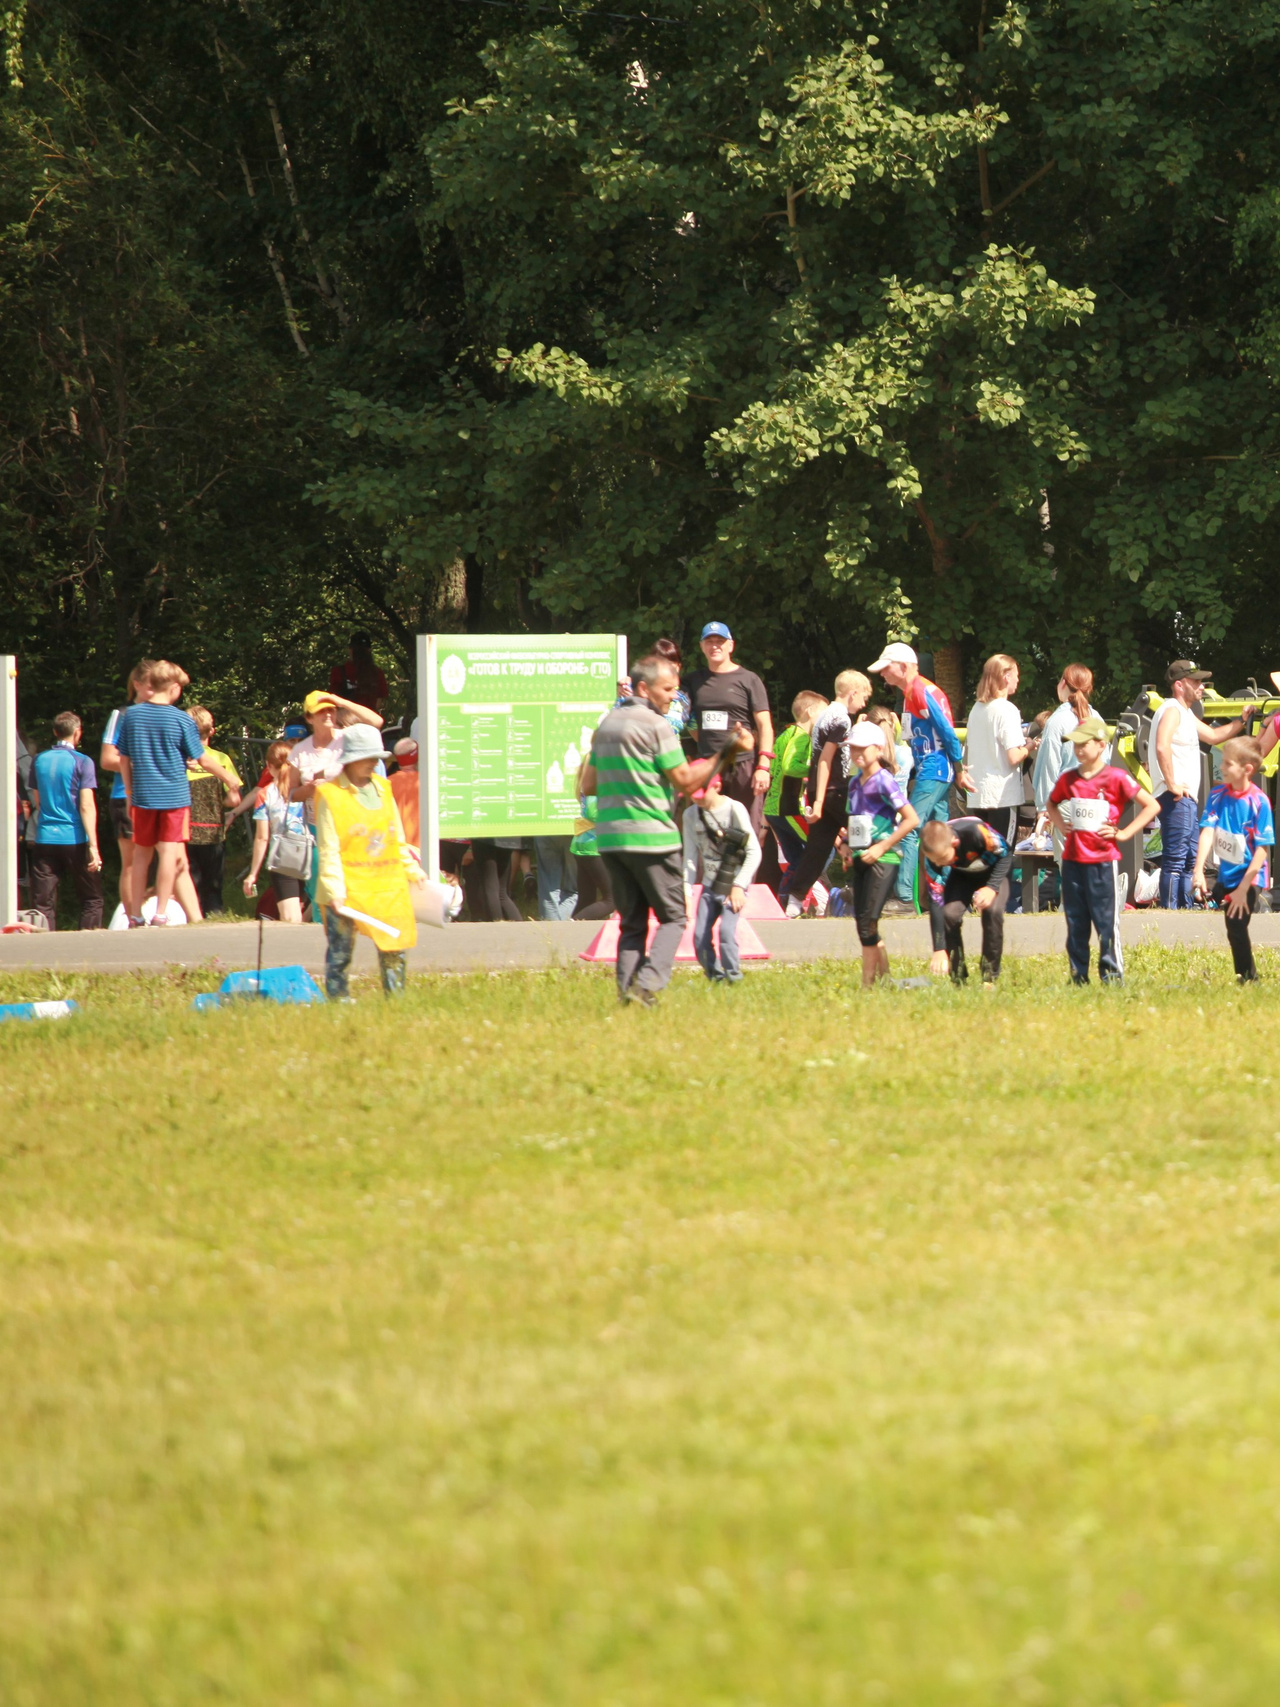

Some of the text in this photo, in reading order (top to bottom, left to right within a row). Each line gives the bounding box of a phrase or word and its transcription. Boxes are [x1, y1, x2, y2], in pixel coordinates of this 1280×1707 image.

[501, 662, 509, 675] К
[509, 662, 536, 676] ТРУДУ
[537, 662, 544, 675] И
[705, 713, 722, 722] 832
[1075, 807, 1094, 818] 606
[1218, 838, 1232, 852] 602
